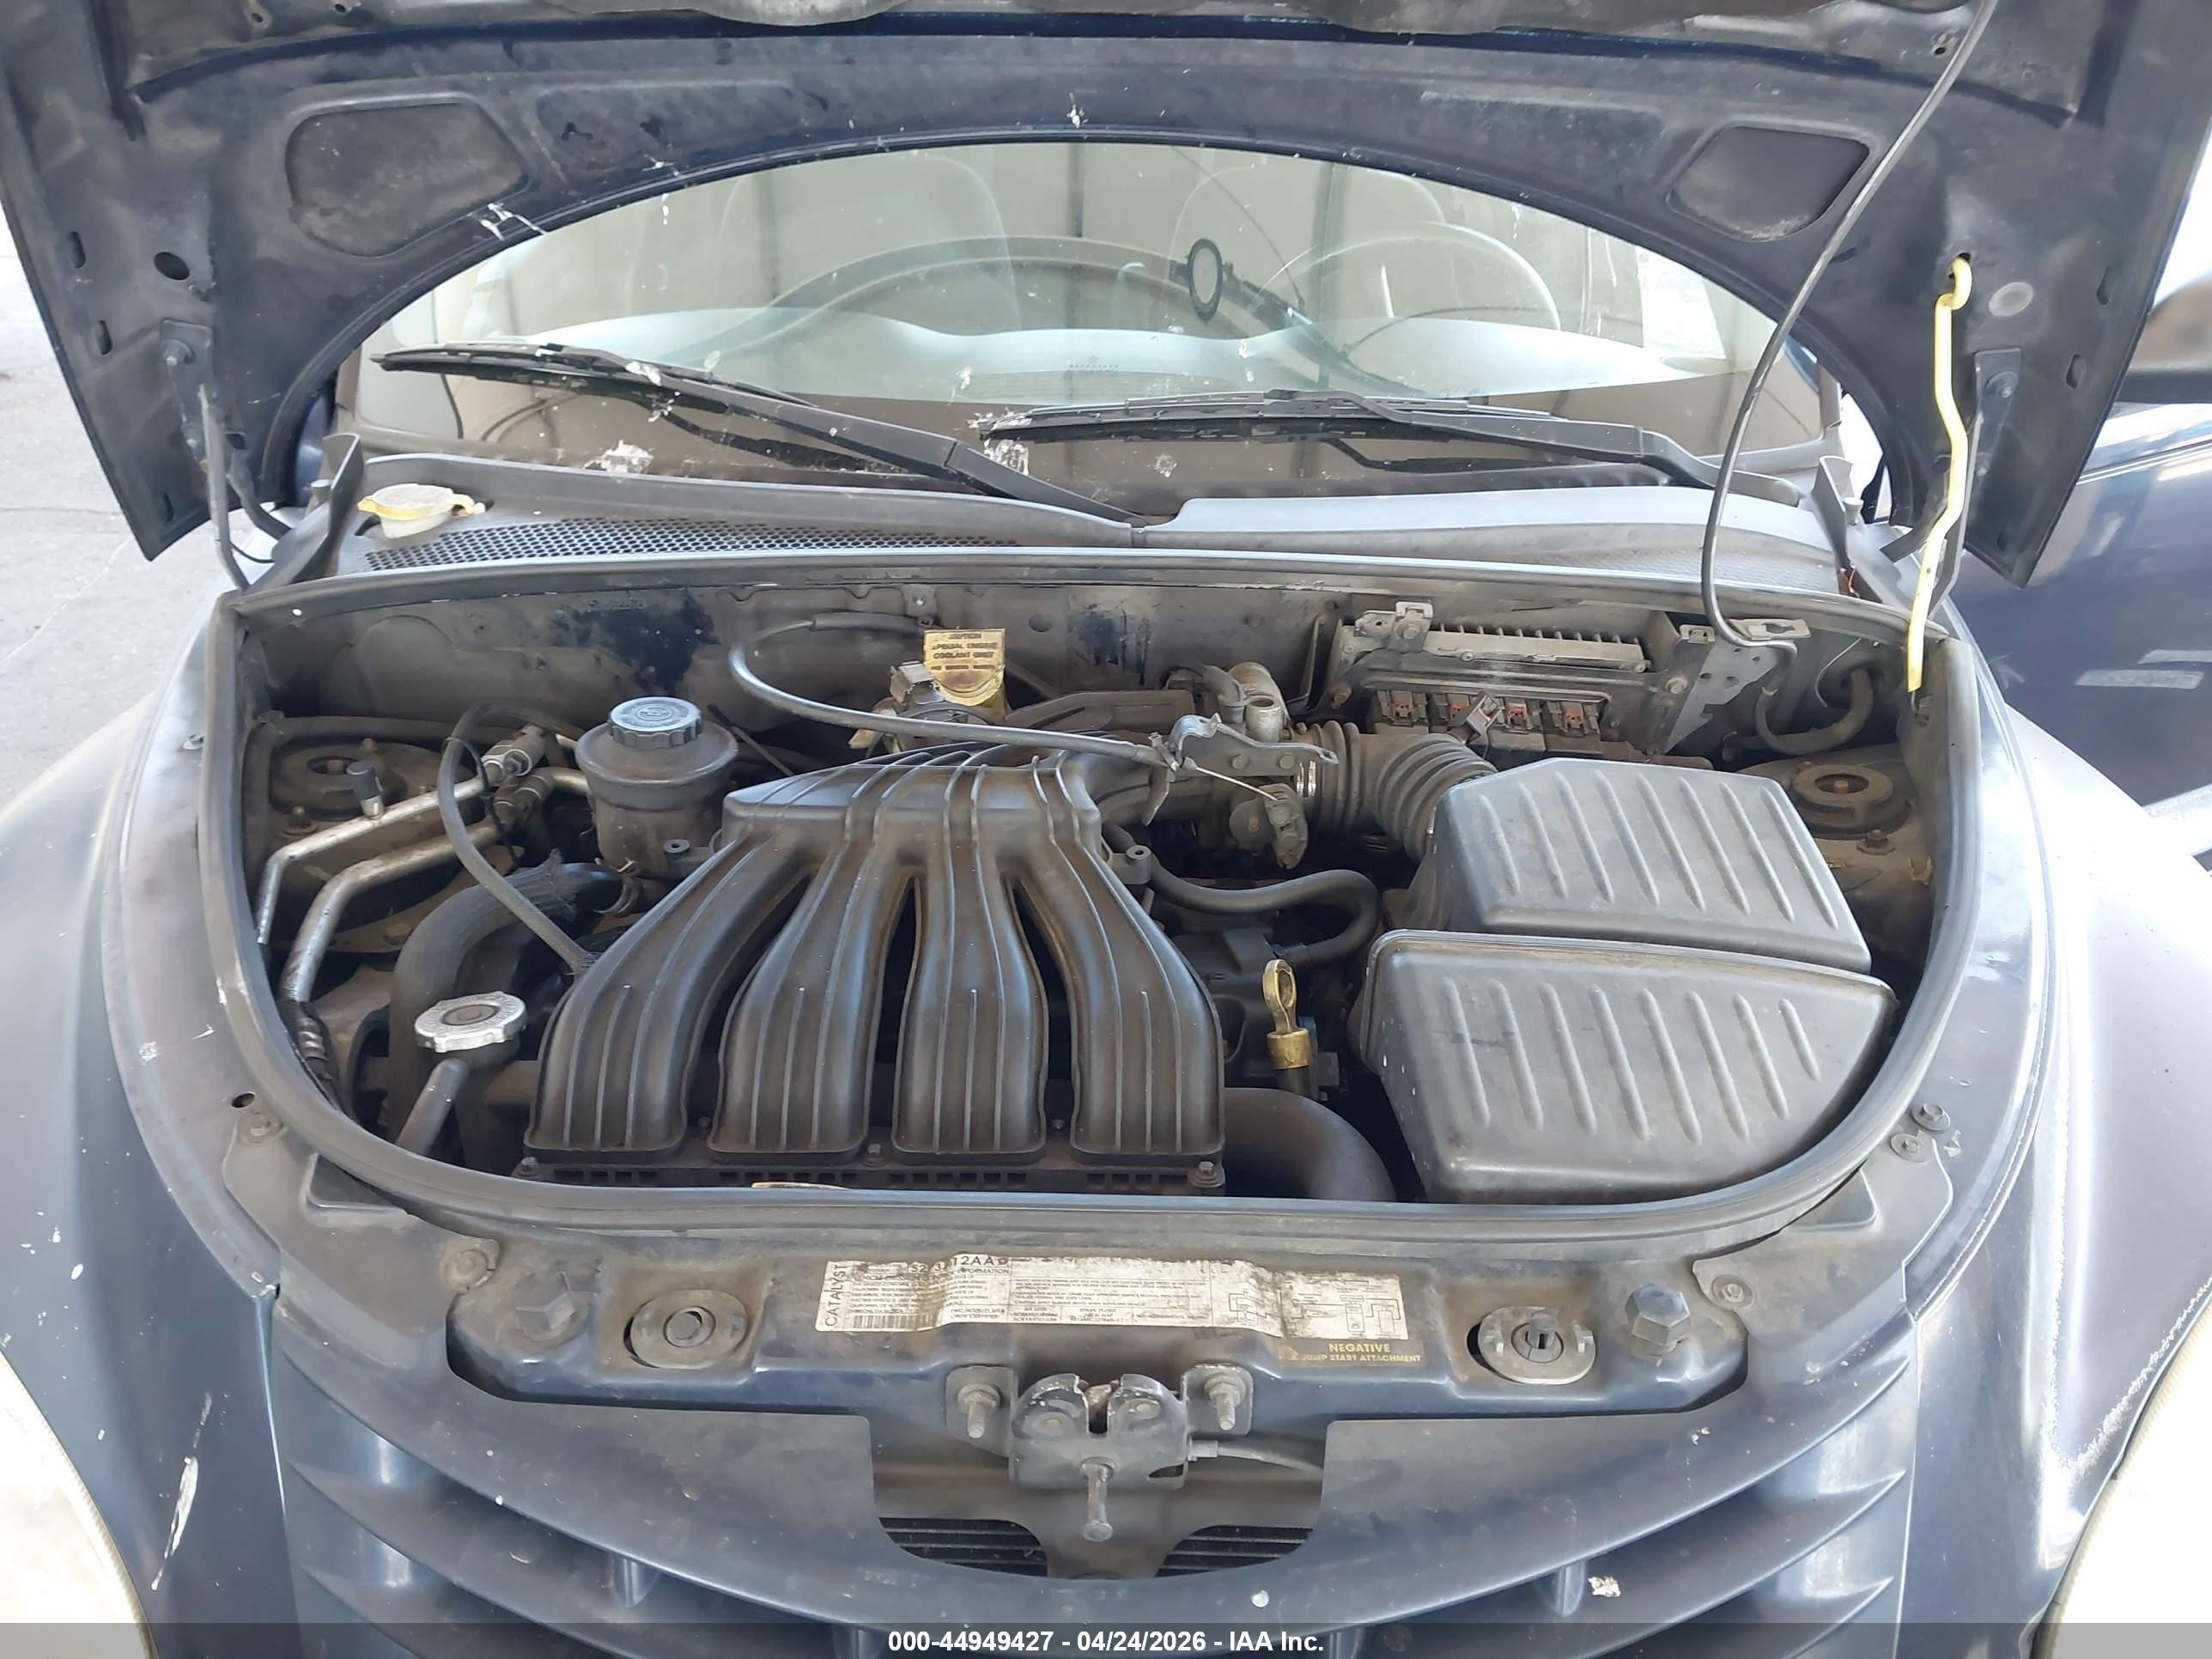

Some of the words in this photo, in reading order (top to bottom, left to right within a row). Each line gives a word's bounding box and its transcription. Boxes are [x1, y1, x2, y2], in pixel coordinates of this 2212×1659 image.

[824, 1264, 848, 1327] CATALYST
[1328, 1343, 1391, 1353] NEGATIVE
[1330, 1353, 1358, 1362] START
[1360, 1354, 1421, 1363] ATTACHMENT
